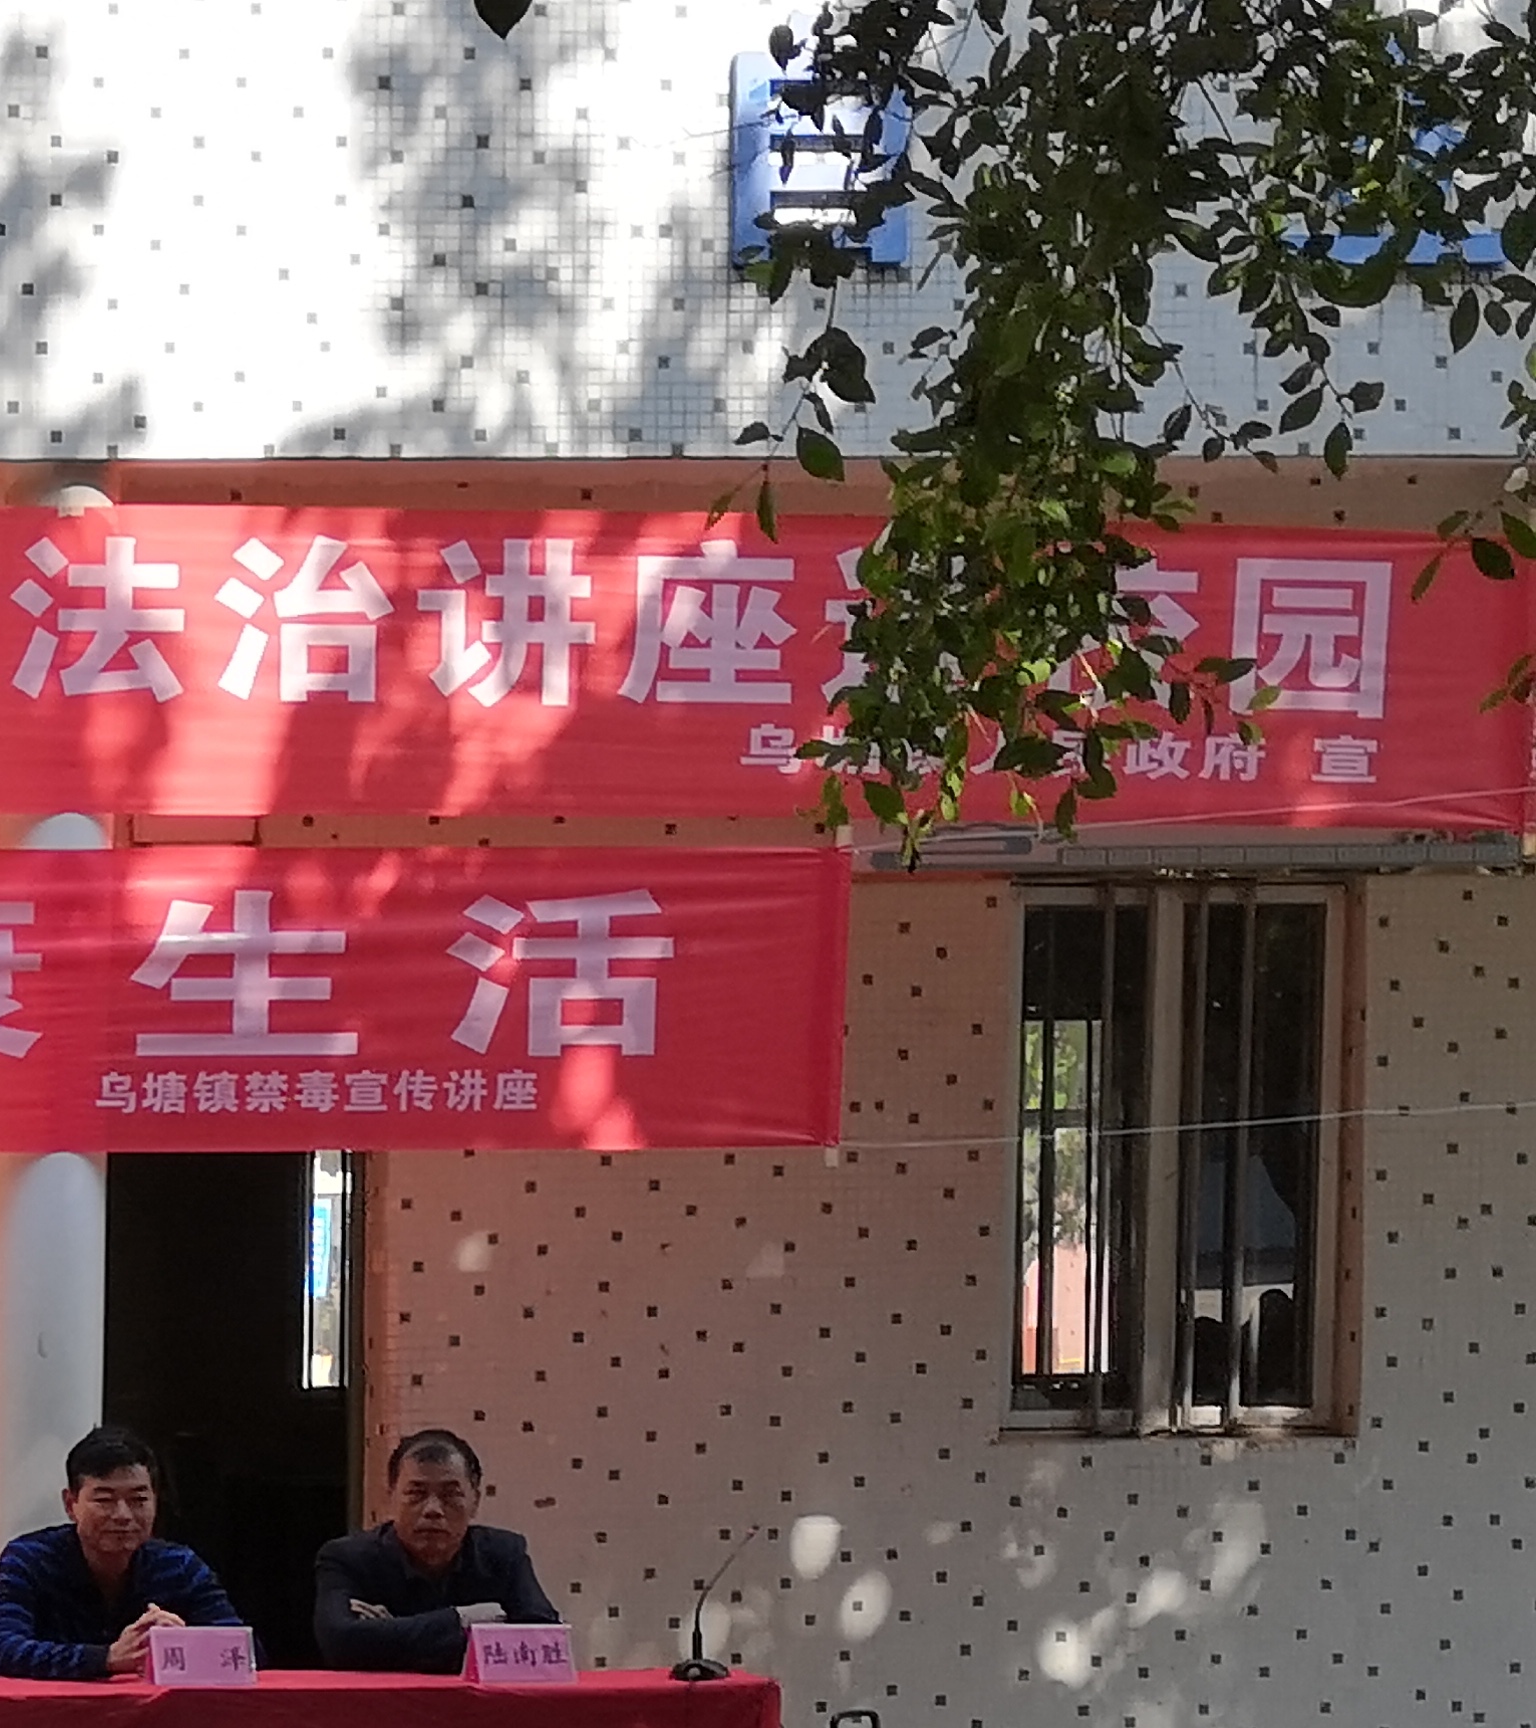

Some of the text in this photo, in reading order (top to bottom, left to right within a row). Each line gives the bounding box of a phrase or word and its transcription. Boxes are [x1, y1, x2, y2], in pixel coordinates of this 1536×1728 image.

[1311, 735, 1381, 784] 宣
[95, 1069, 538, 1114] 乌塘镇禁毒宣传讲座
